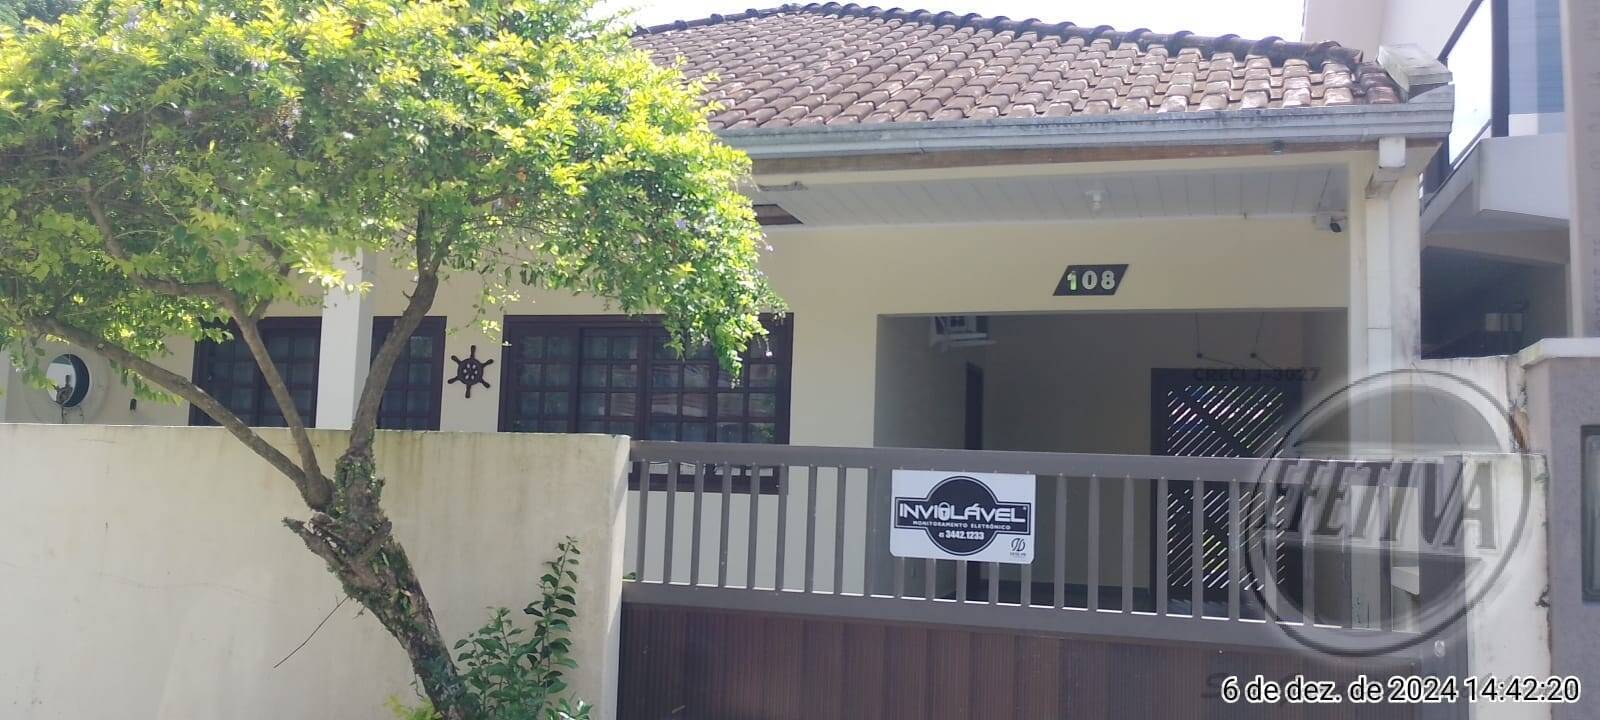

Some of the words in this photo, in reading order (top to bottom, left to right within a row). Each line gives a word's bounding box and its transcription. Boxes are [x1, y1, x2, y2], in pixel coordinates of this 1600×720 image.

[1067, 270, 1115, 290] 108
[899, 502, 1026, 522] INVIOLÁVEL
[945, 530, 985, 540] 3442.1233
